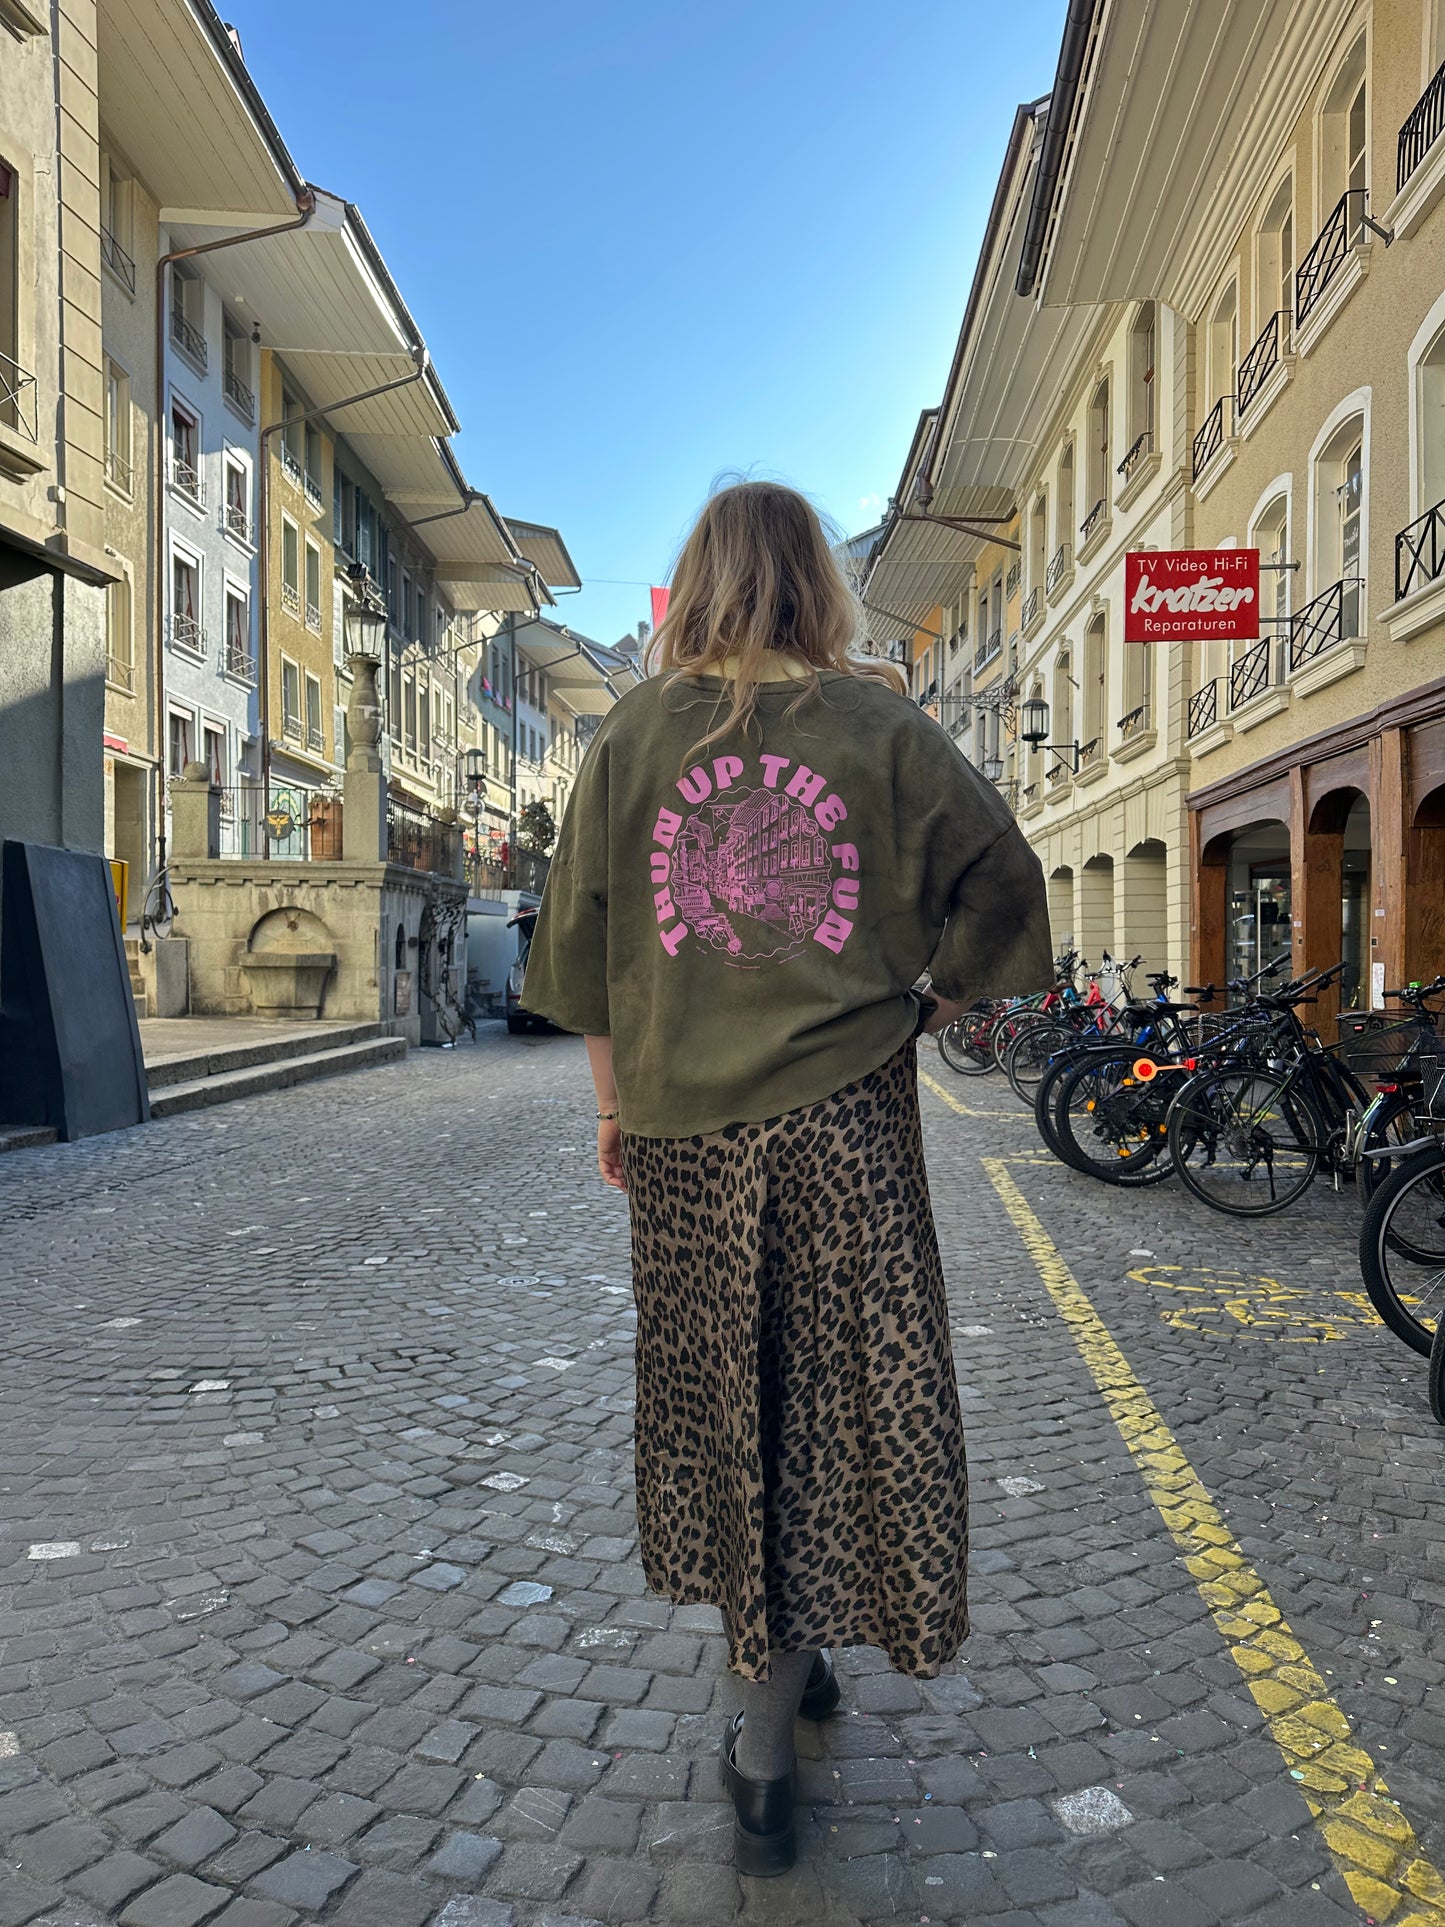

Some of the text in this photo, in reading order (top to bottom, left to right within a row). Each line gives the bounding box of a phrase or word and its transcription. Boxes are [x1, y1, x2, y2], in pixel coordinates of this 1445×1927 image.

[1138, 557, 1248, 573] TV Video Hi-Fi
[1131, 575, 1254, 614] kratzer
[1144, 618, 1236, 634] Reparaturen
[650, 753, 860, 957] THUN UP THE FUN
